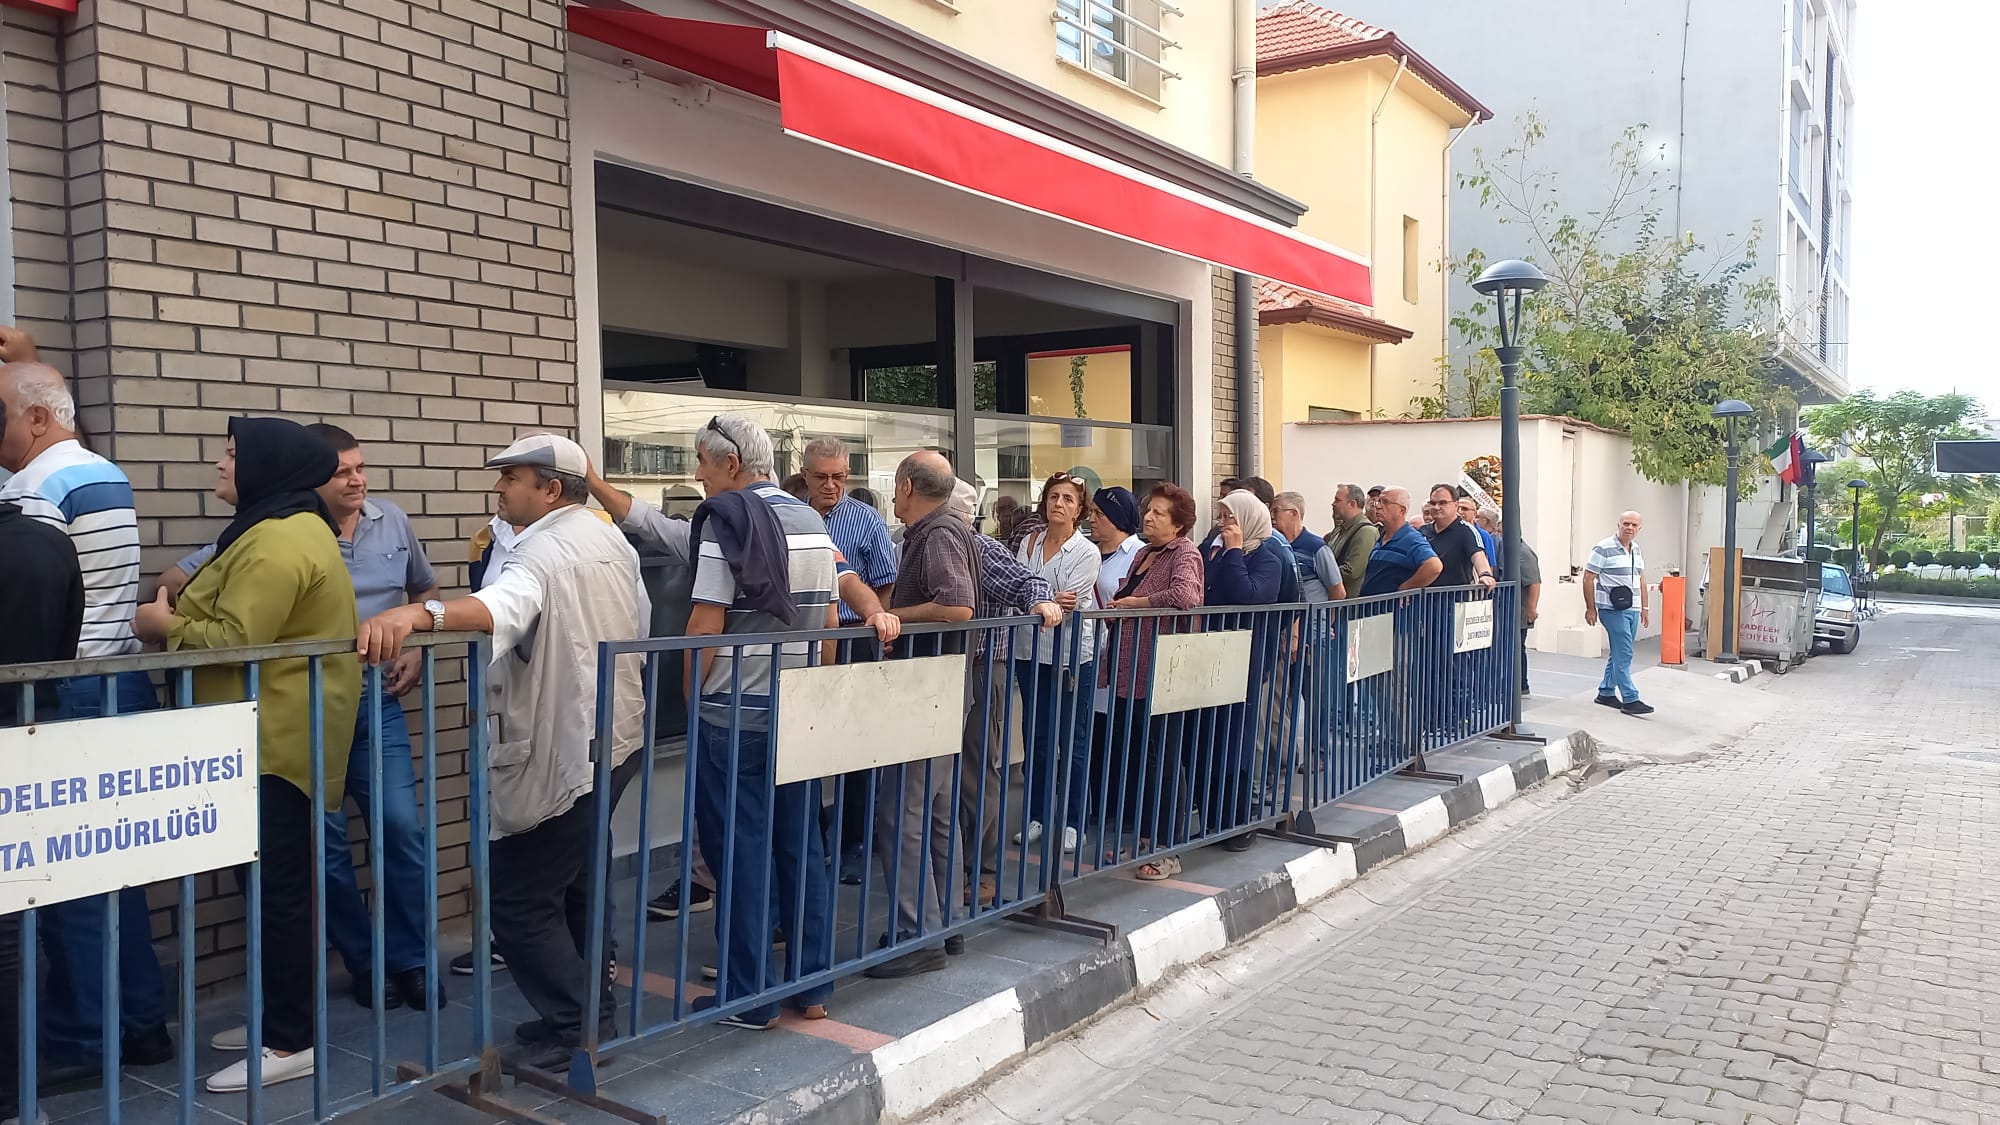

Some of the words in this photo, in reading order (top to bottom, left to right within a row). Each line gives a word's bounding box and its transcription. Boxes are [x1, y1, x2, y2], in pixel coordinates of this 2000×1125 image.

[98, 748, 243, 800] BELEDİYESİ
[0, 841, 35, 872] TA
[46, 803, 218, 863] MÜDÜRLÜĞÜ
